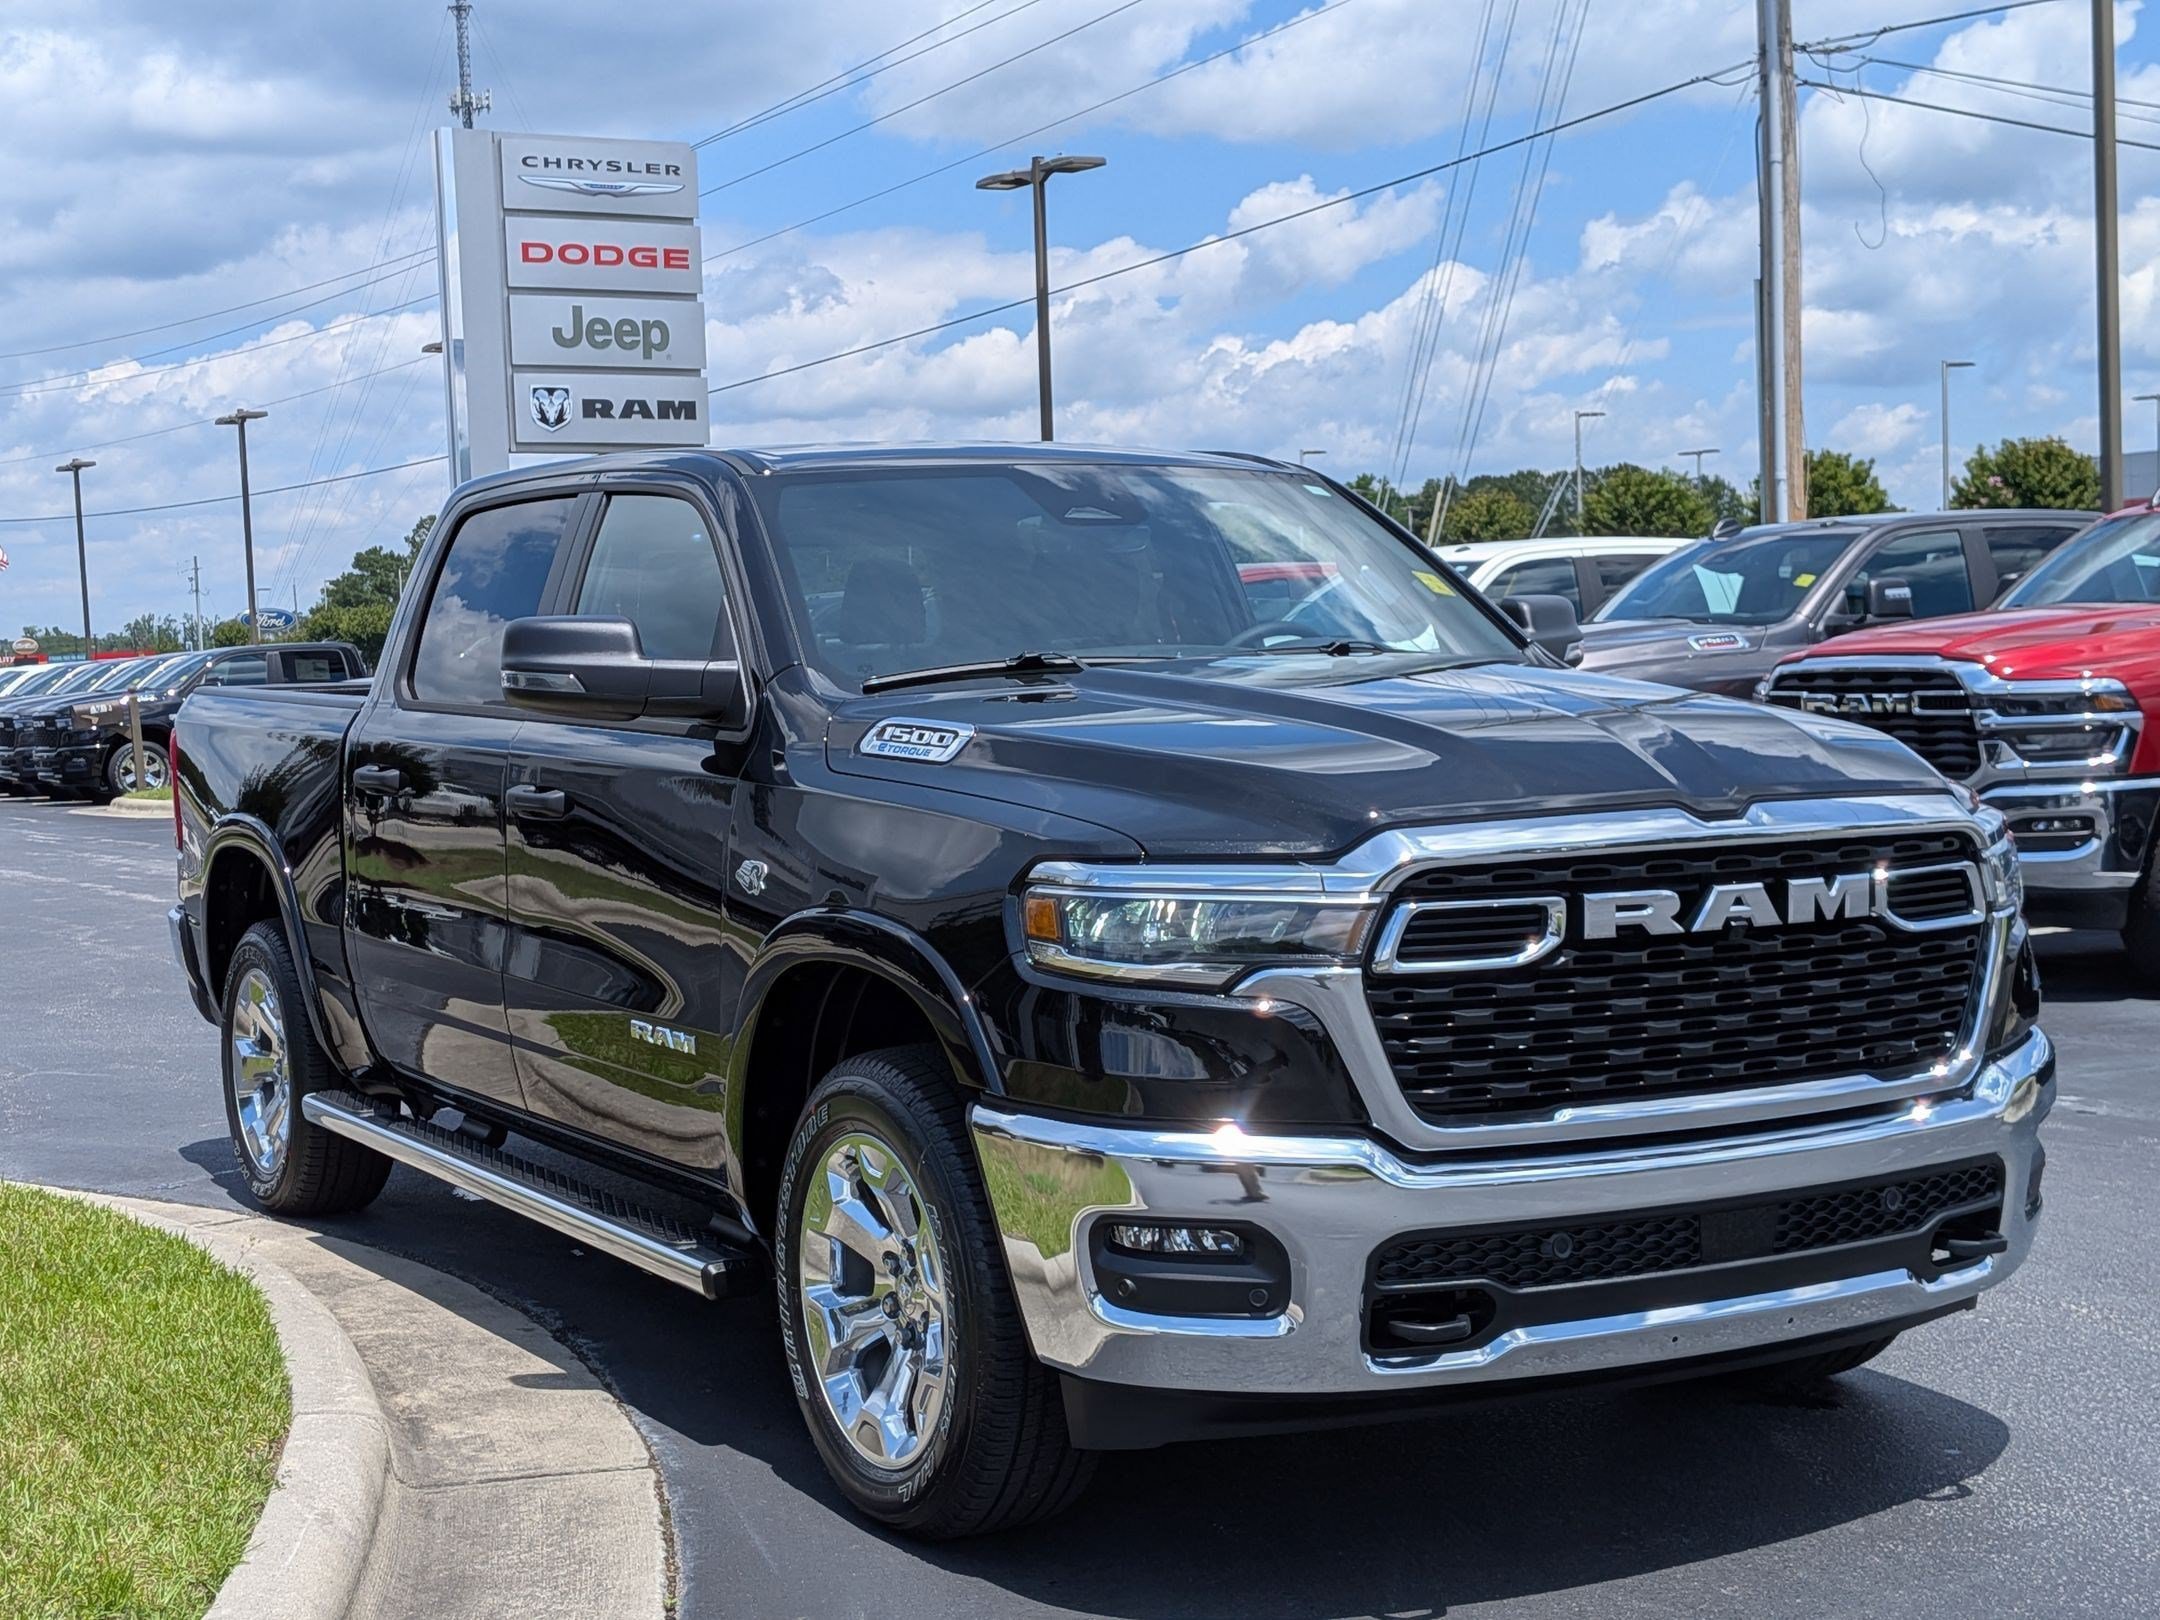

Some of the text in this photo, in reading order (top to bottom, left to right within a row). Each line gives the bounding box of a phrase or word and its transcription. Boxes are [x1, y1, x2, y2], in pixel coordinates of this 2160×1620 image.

[521, 156, 680, 176] CHRYSLER
[521, 242, 690, 269] DODGE
[552, 305, 670, 360] Jeep
[582, 398, 697, 420] RAM
[1802, 692, 1909, 713] RAM
[881, 726, 954, 746] 1500
[1583, 873, 1871, 939] RAM
[630, 1019, 697, 1056] RAM
